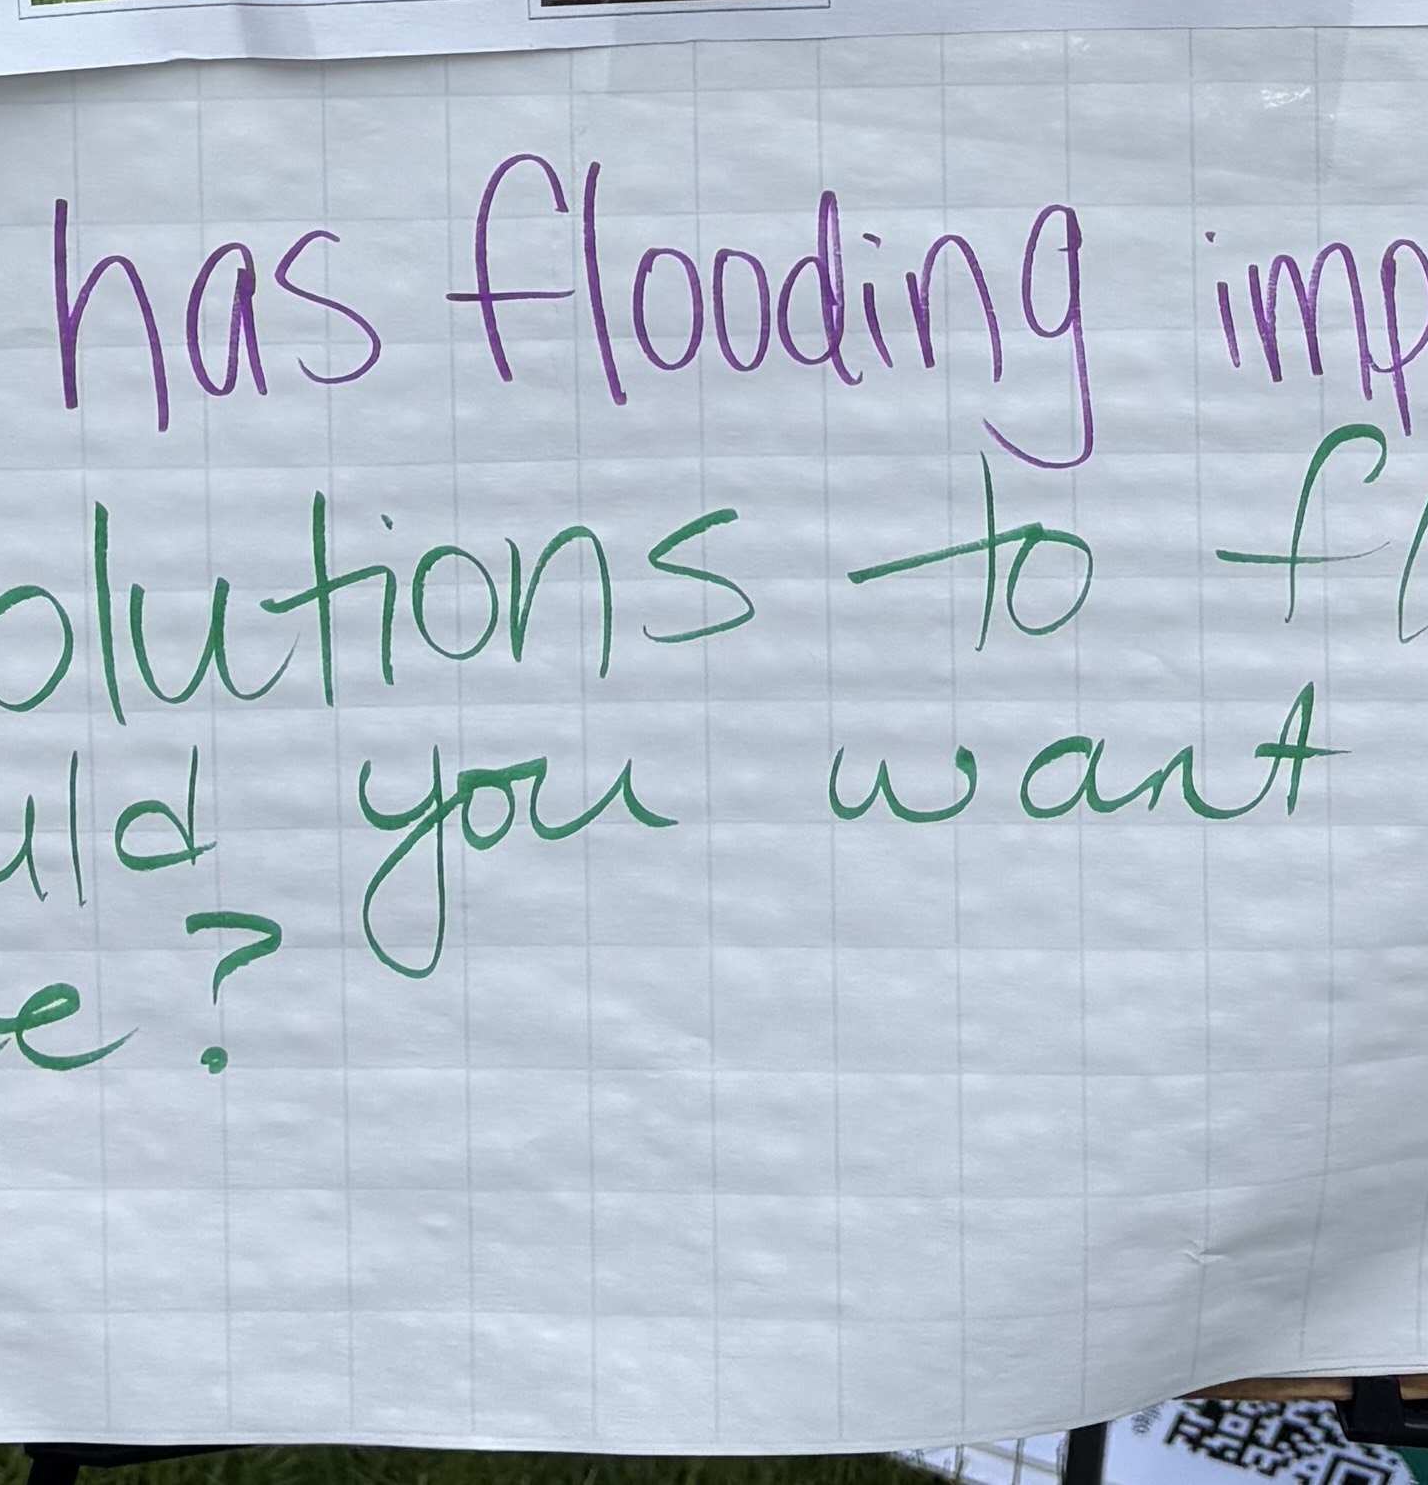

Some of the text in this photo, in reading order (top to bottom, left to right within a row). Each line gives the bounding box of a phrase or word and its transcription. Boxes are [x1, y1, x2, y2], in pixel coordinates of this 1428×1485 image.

[53, 198, 382, 431] has
[447, 153, 1094, 469] flooding
[847, 450, 1095, 653] to
[357, 744, 679, 978] you
[828, 681, 1351, 823] want
